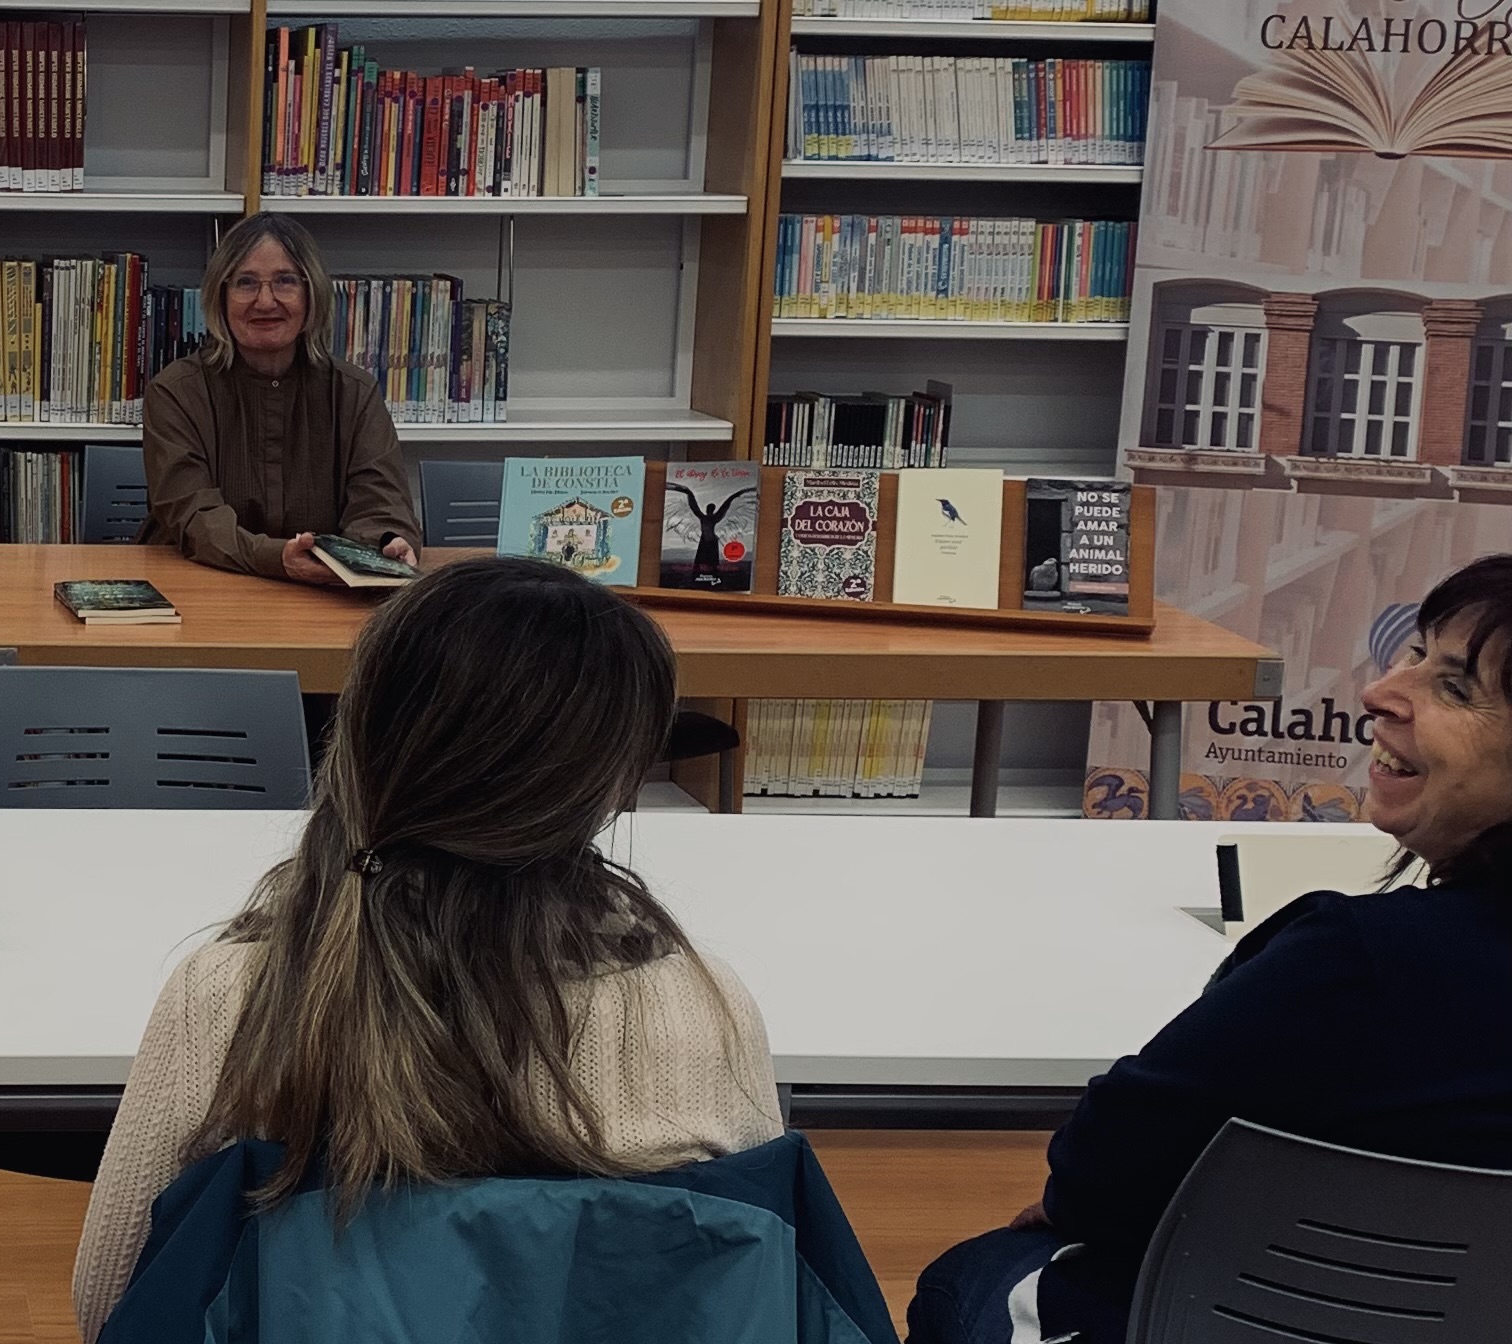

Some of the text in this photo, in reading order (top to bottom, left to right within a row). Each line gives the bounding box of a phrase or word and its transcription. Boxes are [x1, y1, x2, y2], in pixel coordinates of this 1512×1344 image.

[521, 465, 632, 478] LA BIBLIOTECA
[532, 478, 547, 489] DE
[1077, 491, 1119, 504] NO SE
[810, 506, 850, 517] LA CAJA
[1074, 505, 1121, 518] PUEDE
[795, 519, 865, 532] DEL CORAZÓN
[1076, 520, 1118, 532] AMAR
[1079, 534, 1114, 546] A UN
[1069, 548, 1125, 561] ANIMAL
[1069, 563, 1123, 575] HERIDO
[1205, 742, 1347, 768] Ayuntamiento
